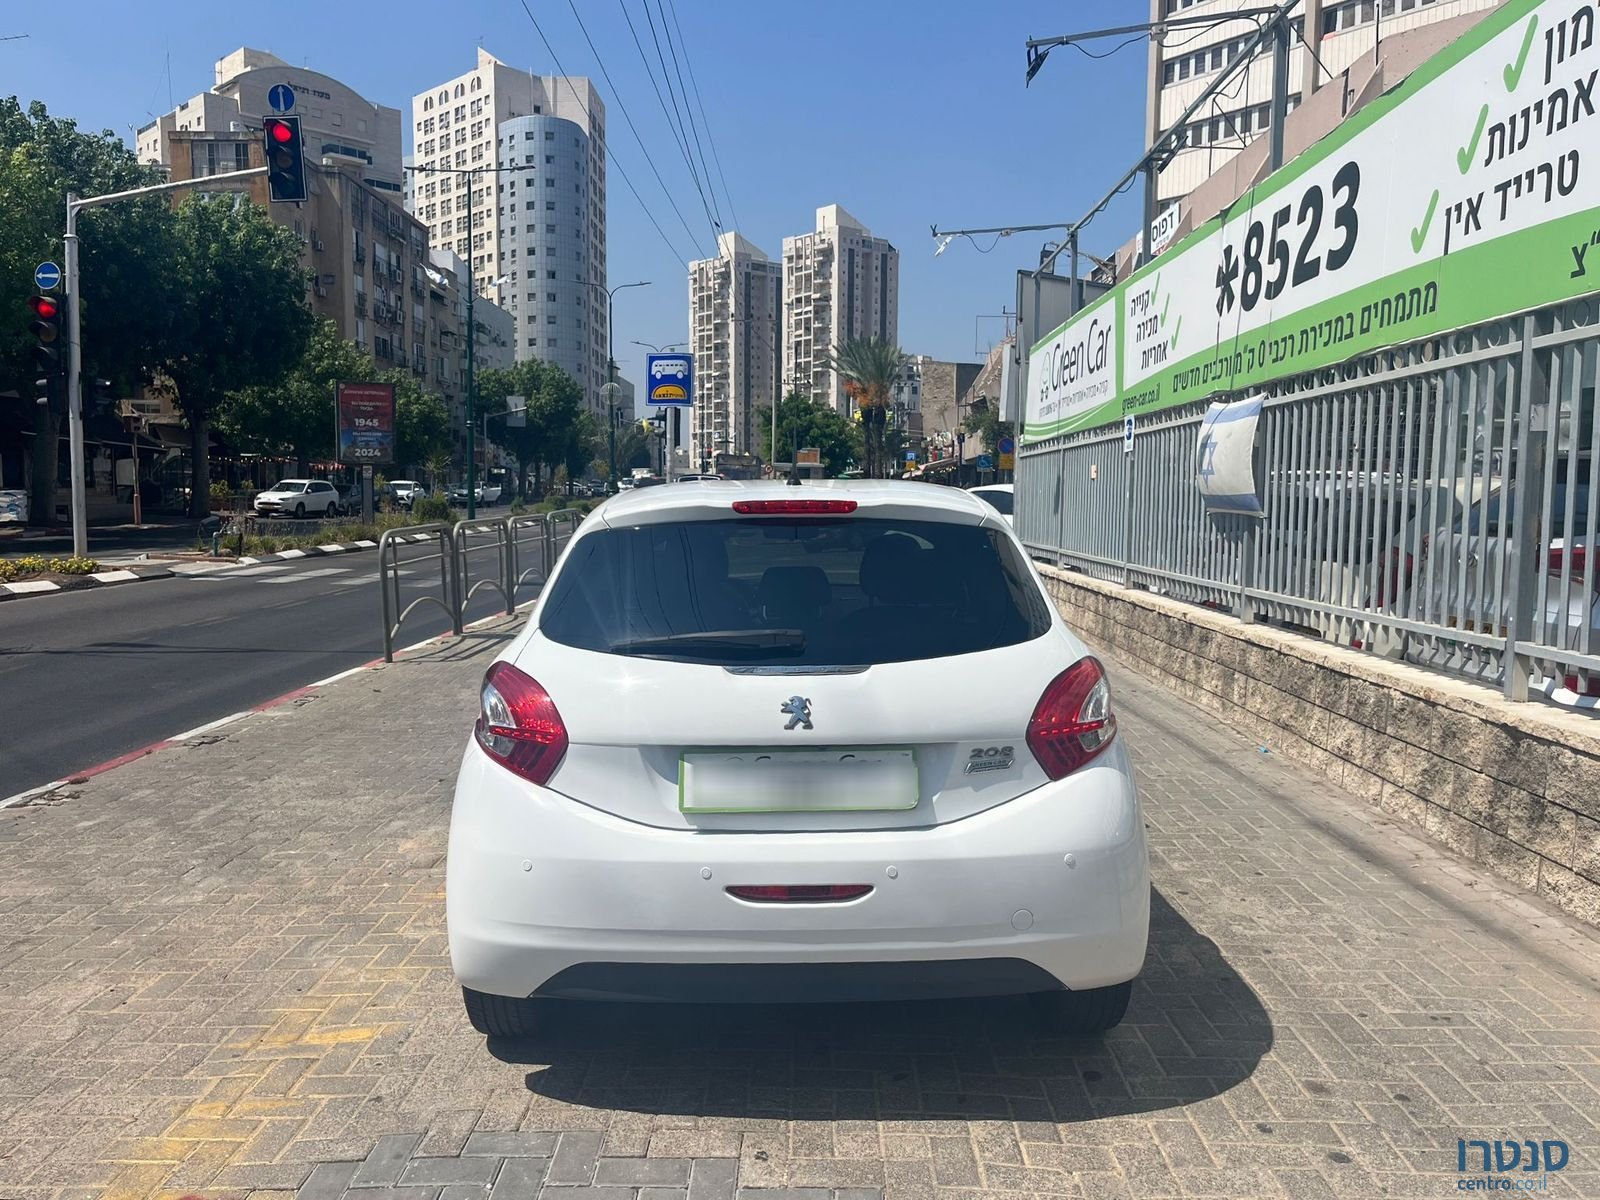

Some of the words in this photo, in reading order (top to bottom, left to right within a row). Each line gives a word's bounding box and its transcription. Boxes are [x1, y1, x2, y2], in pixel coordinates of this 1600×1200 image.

[1544, 0, 1600, 86] מון
[1484, 69, 1599, 168] אמינות
[1494, 149, 1579, 222] טרייד
[1152, 211, 1174, 243] דפוס
[1443, 191, 1484, 256] אין
[1130, 289, 1150, 317] קנייה
[1359, 280, 1437, 336] מתמחים
[1136, 314, 1158, 343] מכירה
[1297, 315, 1354, 356] במכירת
[1052, 342, 1084, 392] Green
[1087, 318, 1112, 375] Car
[1141, 340, 1169, 370] אחריות
[1258, 339, 1266, 369] 0
[1269, 334, 1295, 364] רכבי
[1172, 366, 1201, 393] חדשים
[1121, 382, 1160, 415] green-car.co.il
[354, 418, 379, 427] 1945
[354, 448, 381, 457] 2024
[970, 746, 1014, 759] 208
